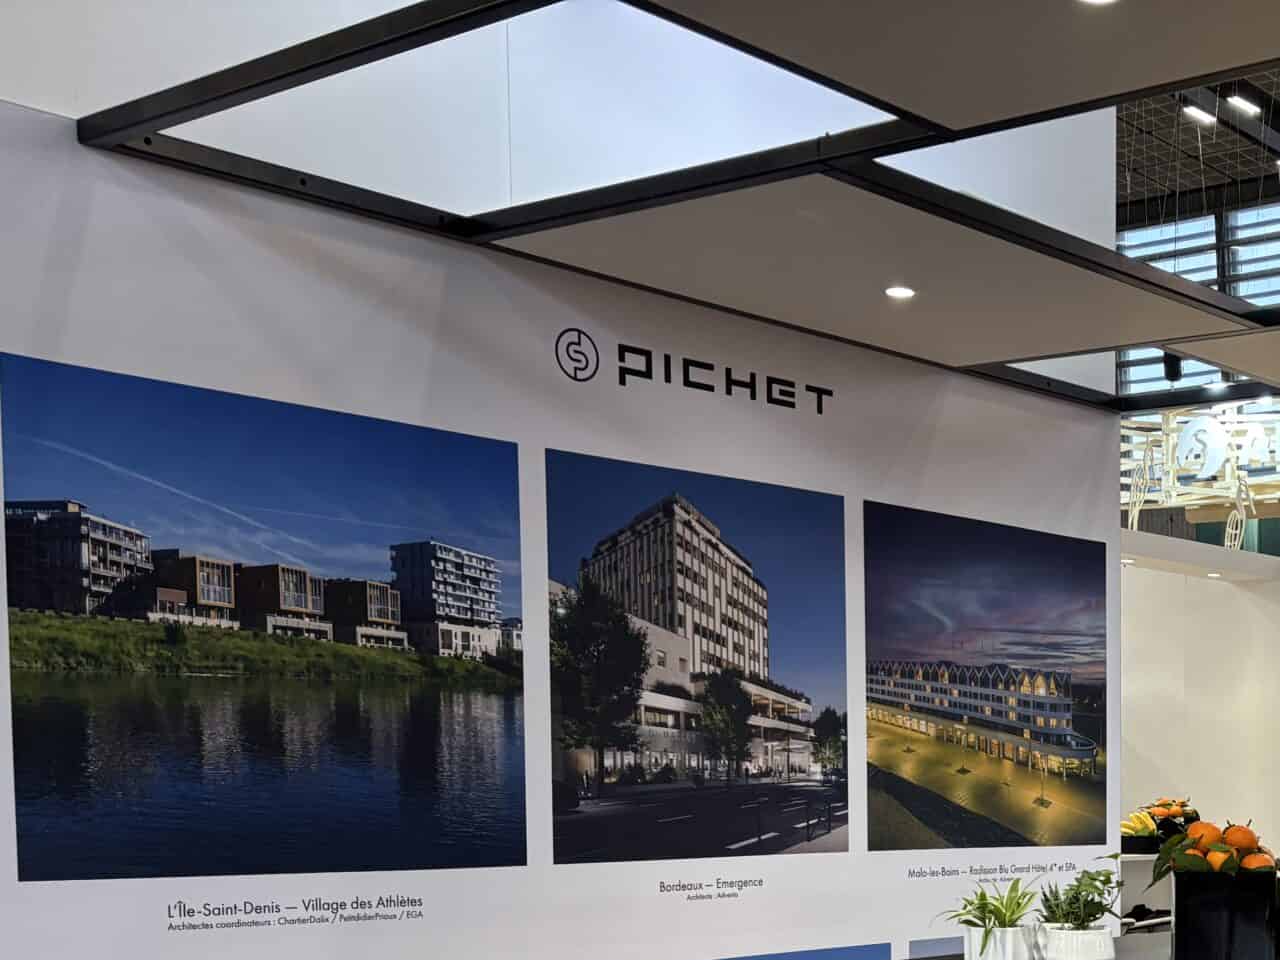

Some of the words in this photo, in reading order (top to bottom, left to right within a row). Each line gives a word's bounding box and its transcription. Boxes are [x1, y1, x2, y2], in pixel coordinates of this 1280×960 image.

[618, 343, 834, 415] PICHET
[908, 866, 960, 878] Malo-les-Bains
[659, 880, 704, 892] Bordeaux
[716, 878, 763, 890] Emergence
[302, 897, 347, 914] Village
[351, 896, 373, 909] des
[376, 894, 423, 909] Athlètes
[168, 921, 214, 931] Architectes
[216, 919, 272, 929] coordinateurs
